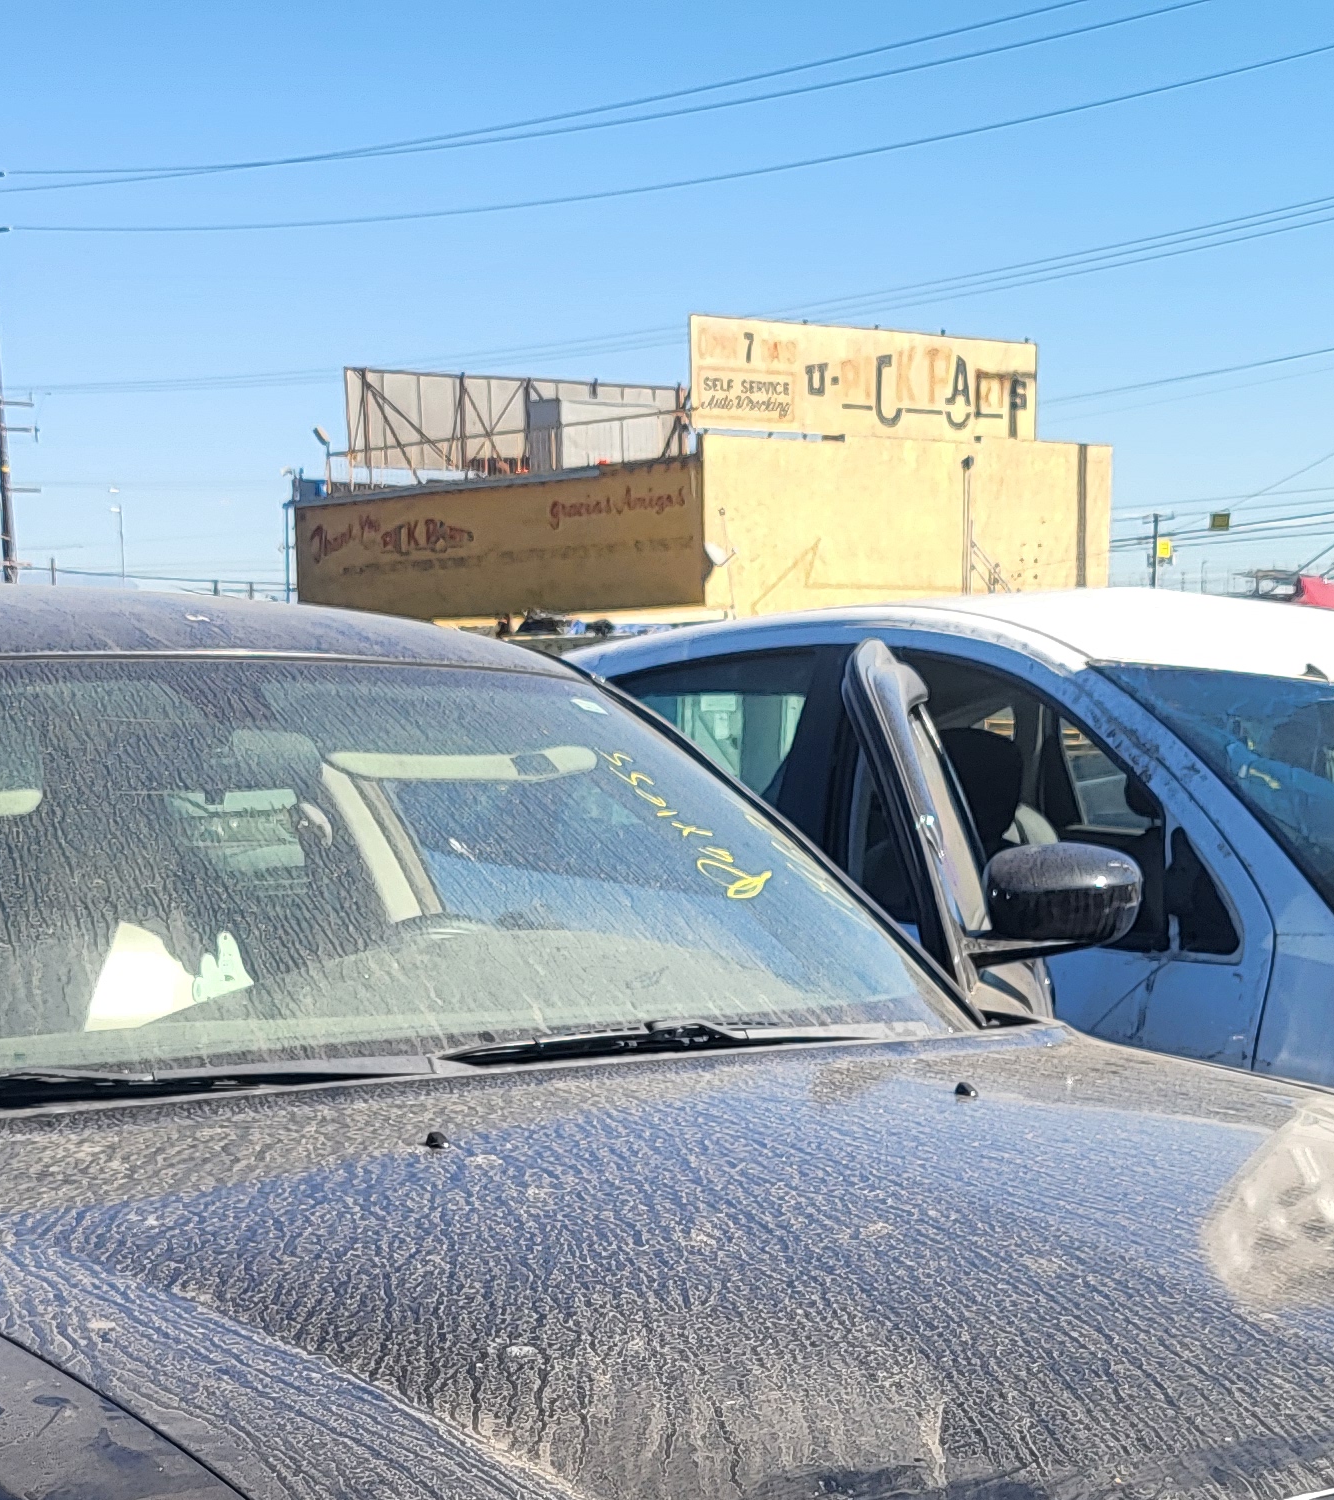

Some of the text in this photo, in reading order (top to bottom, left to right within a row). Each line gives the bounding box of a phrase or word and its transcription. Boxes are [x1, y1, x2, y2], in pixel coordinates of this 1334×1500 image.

[743, 331, 755, 365] 7
[703, 376, 790, 396] SELF SERVICE
